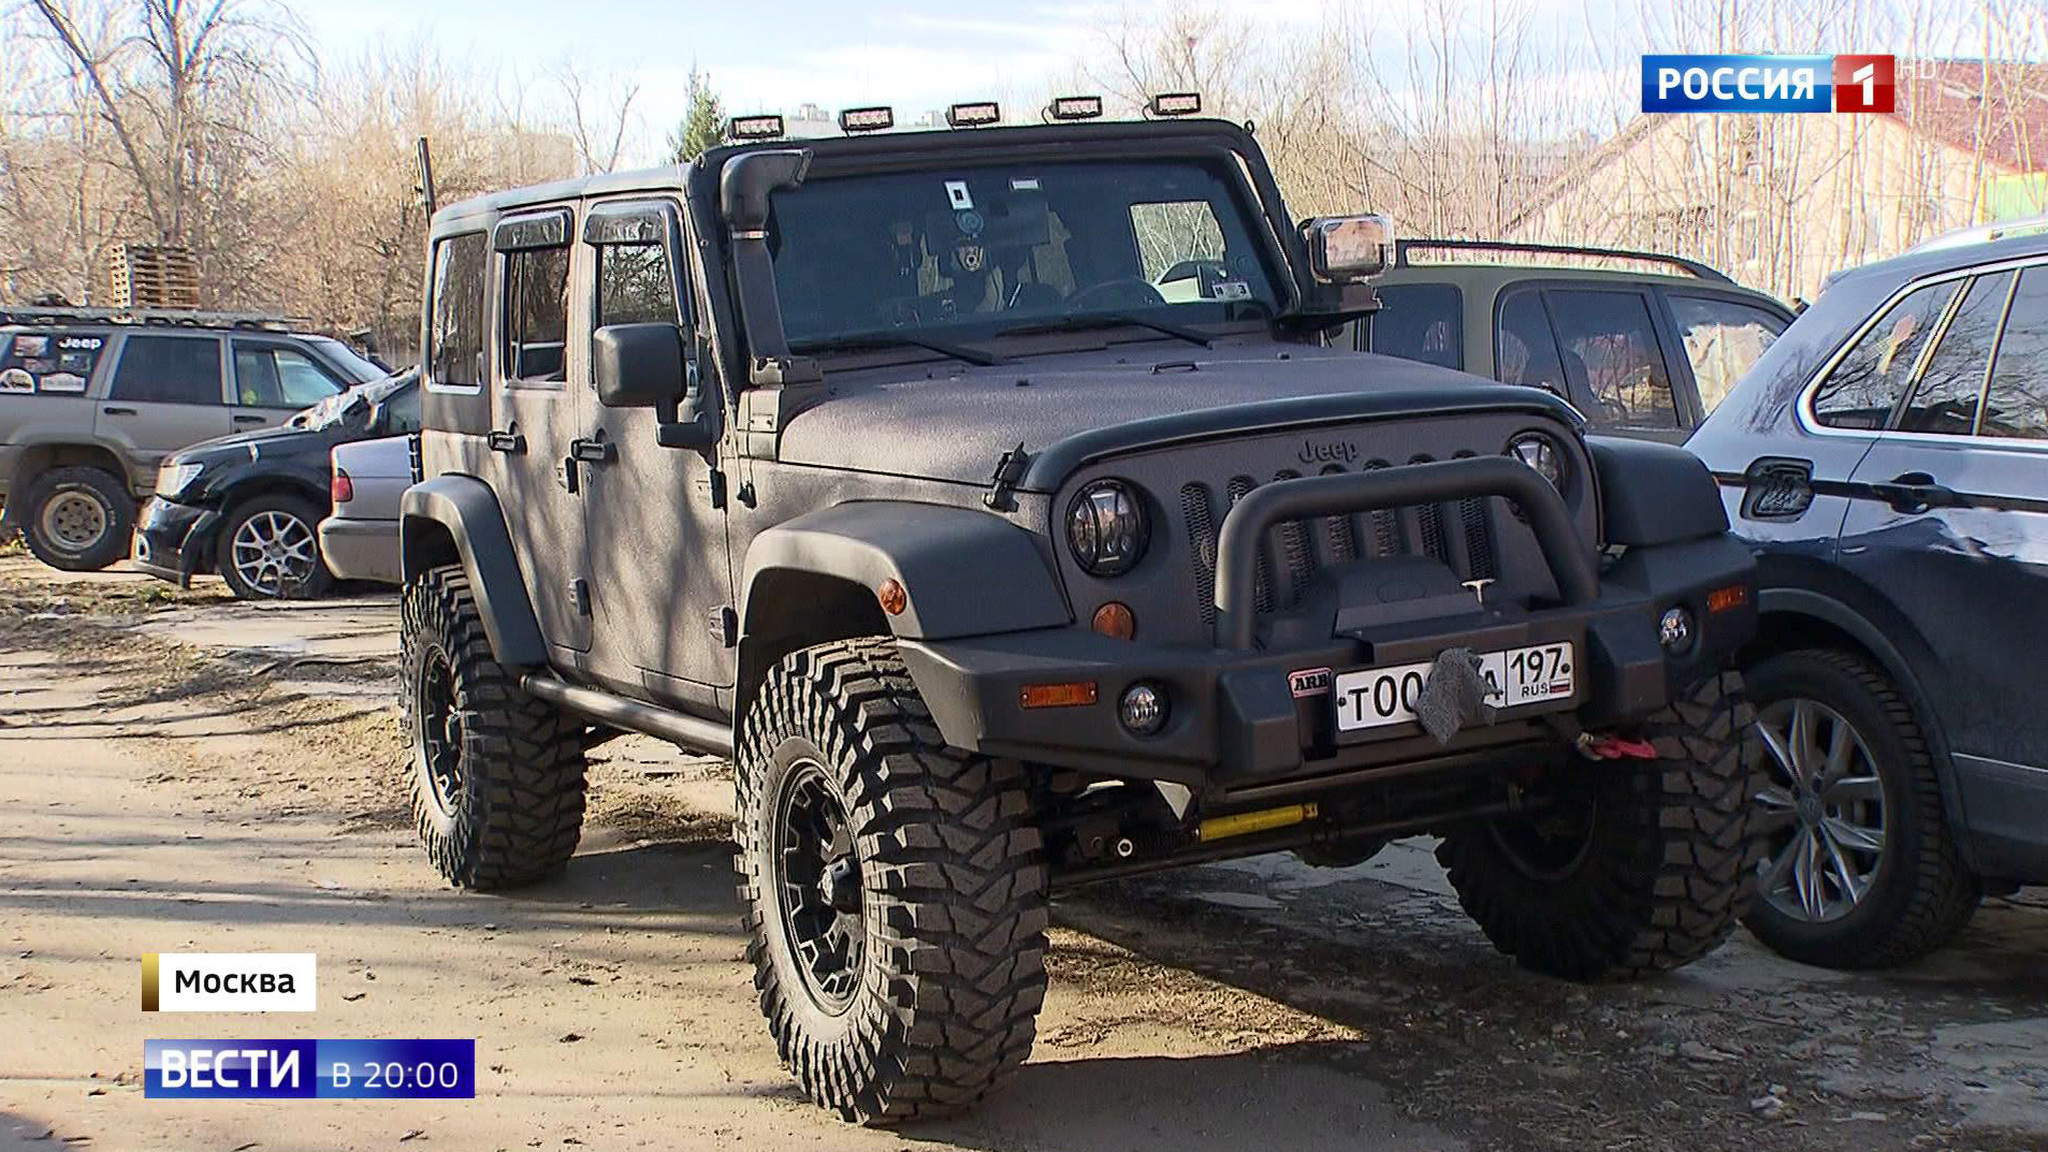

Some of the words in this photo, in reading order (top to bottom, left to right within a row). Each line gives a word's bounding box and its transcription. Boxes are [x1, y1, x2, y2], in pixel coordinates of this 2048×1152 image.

[58, 337, 102, 350] Jeep
[1298, 440, 1360, 463] Jeep
[1510, 647, 1563, 685] 197
[1521, 682, 1549, 698] RUS
